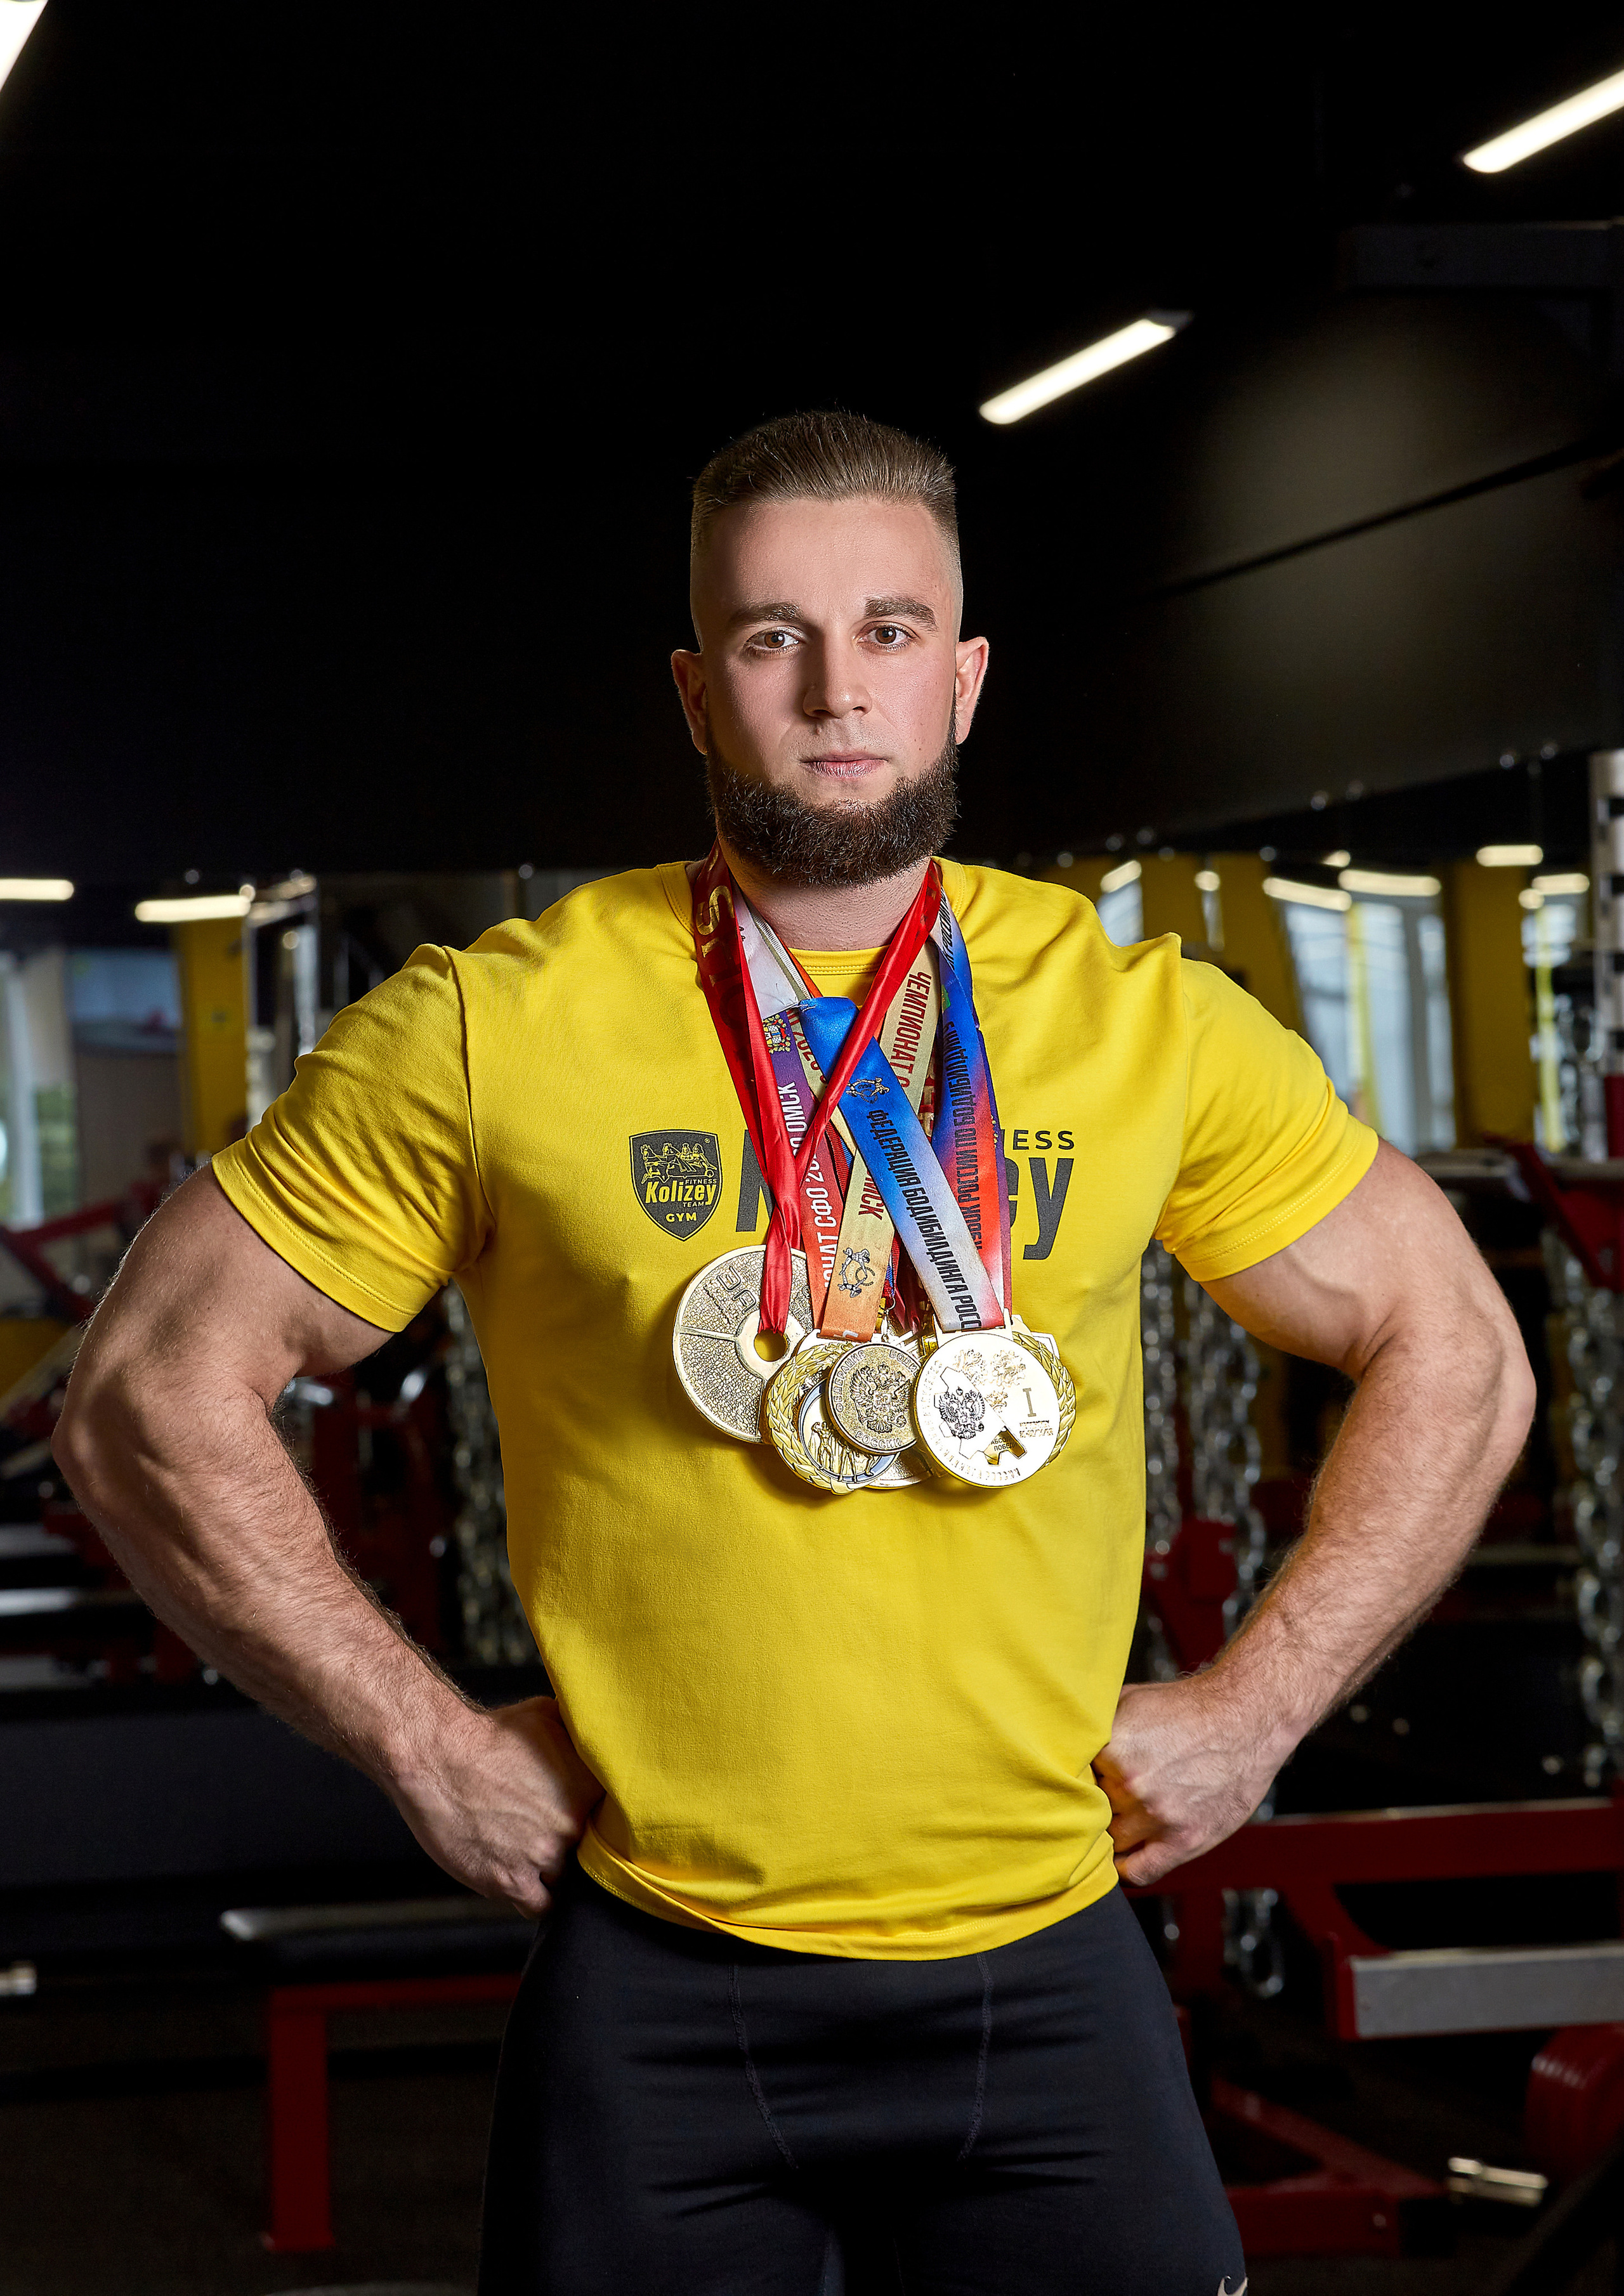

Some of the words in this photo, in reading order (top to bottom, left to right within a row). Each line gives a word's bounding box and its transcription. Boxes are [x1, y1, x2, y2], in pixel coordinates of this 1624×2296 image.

[889, 971, 932, 1074] ЧЕМПИОНАТ
[777, 1081, 808, 1133] ОМСК
[955, 1126, 978, 1146] ПО
[645, 1180, 717, 1206] Kolizey
[858, 1170, 884, 1220] МСК
[956, 1147, 980, 1200] РОССИИ
[665, 1212, 697, 1222] GYM
[805, 1187, 837, 1227] СФО
[867, 1109, 917, 1186] ФЕДЕРАЦИЯ
[901, 1186, 969, 1295] БОДИБИЛДИНГА
[834, 1350, 867, 1412] ФЕДЕРАЦИЯ
[855, 1430, 901, 1449] РОССИИ
